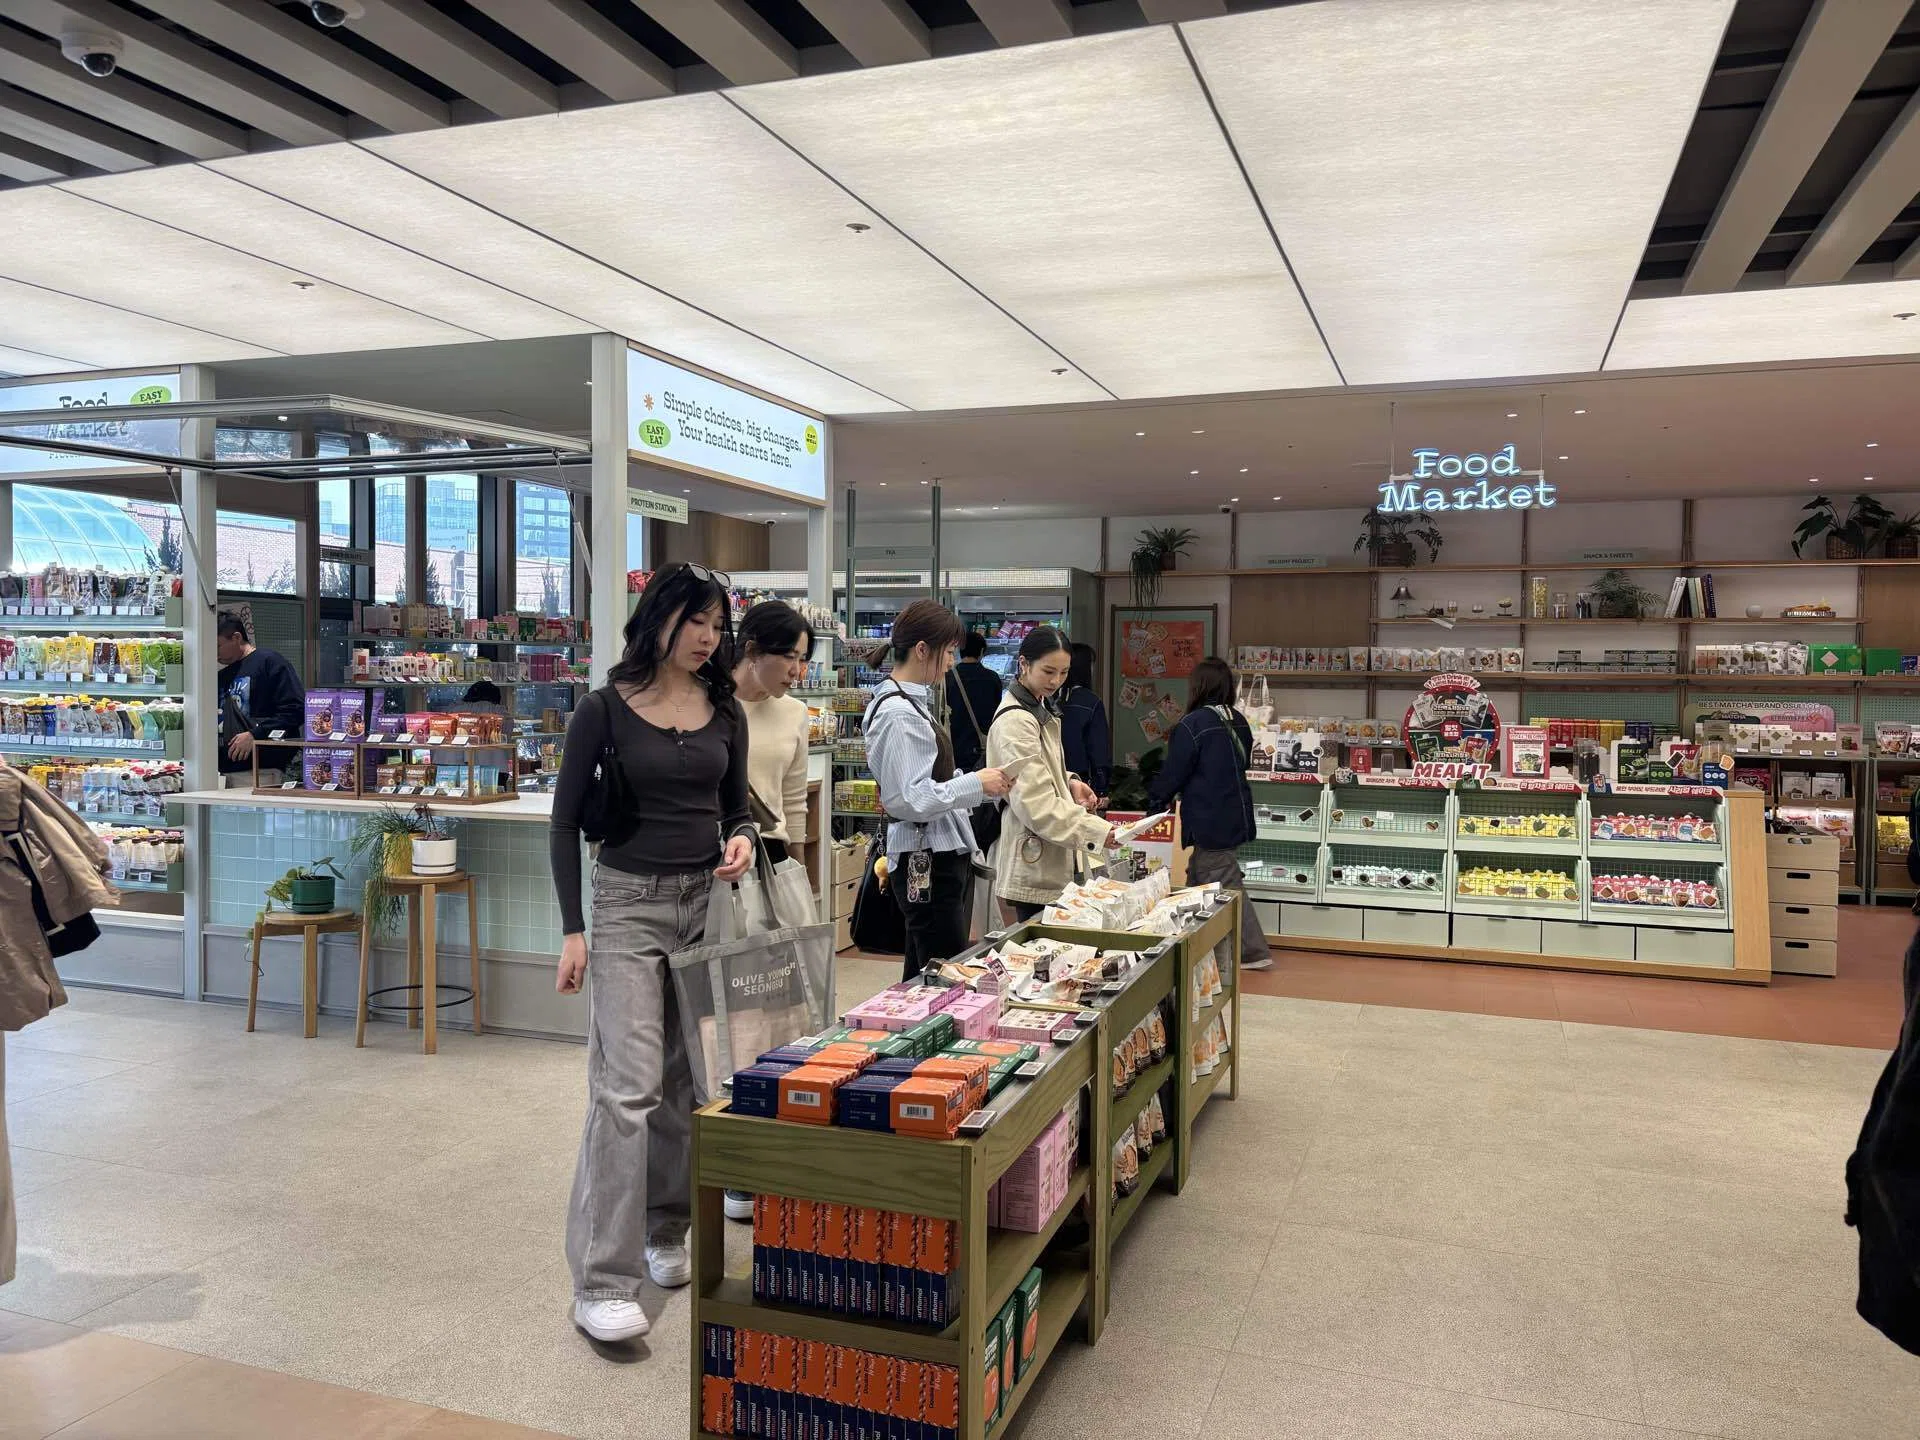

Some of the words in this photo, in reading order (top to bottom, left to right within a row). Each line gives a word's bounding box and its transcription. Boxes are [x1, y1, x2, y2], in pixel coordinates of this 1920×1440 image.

[140, 390, 163, 402] EASY
[663, 390, 702, 420] Simple
[704, 407, 745, 435] choices,
[746, 419, 762, 443] big
[762, 425, 802, 452] changes.
[646, 425, 665, 435] EASY
[649, 434, 664, 446] EAT
[677, 418, 704, 442] Your
[704, 428, 738, 452] health
[739, 442, 769, 462] starts
[770, 448, 792, 468] here.
[1411, 441, 1522, 479] Food
[1376, 478, 1558, 514] Market
[630, 497, 654, 510] PROTEIN
[654, 502, 677, 514] STATION
[1413, 763, 1464, 778] MEAL
[1471, 764, 1490, 779] IT
[732, 974, 765, 987] OLIVE
[744, 978, 783, 996] SEONGSU
